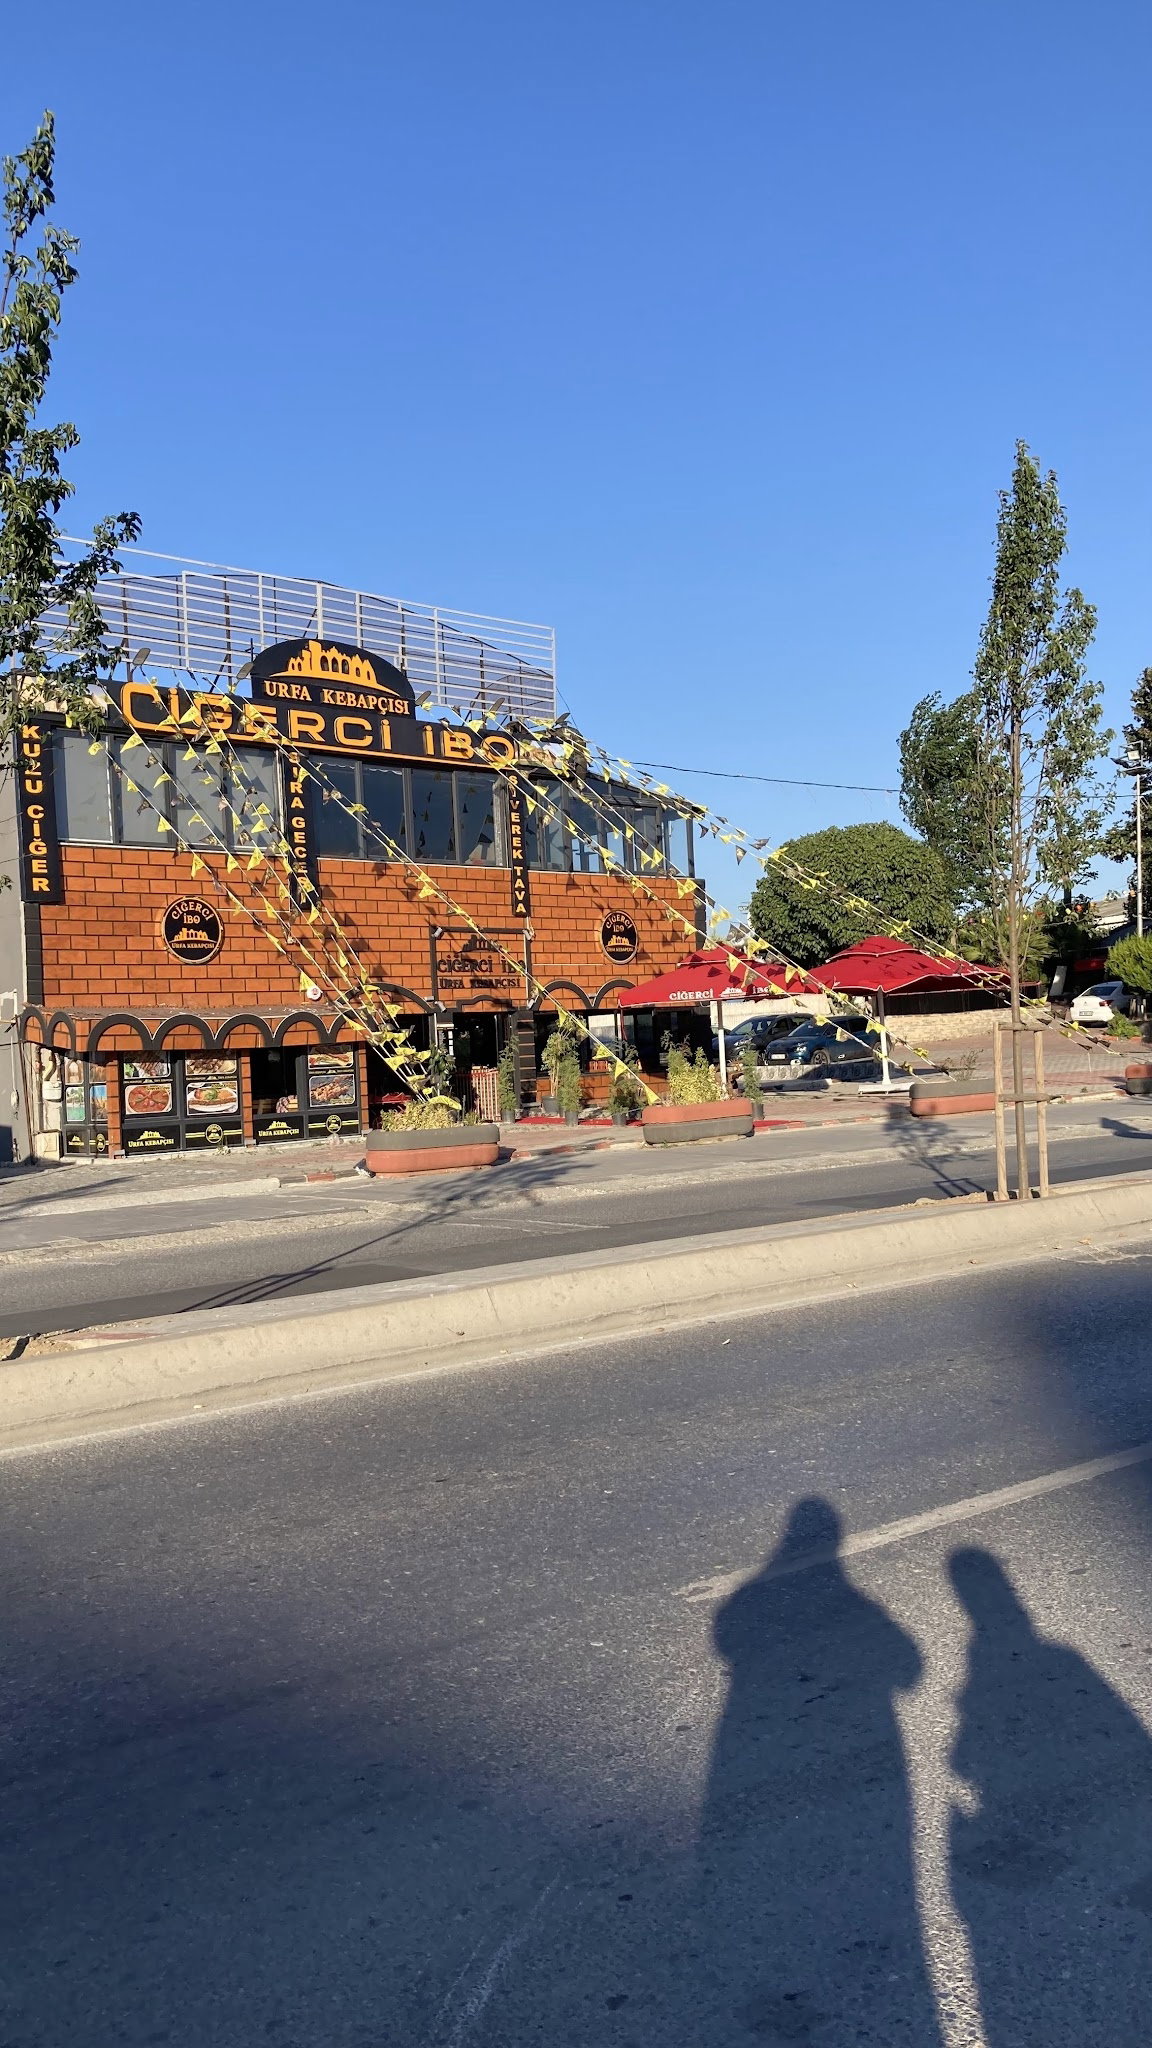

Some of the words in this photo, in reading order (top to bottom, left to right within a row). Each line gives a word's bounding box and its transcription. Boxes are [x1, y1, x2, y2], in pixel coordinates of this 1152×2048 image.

[264, 680, 312, 701] URFA
[320, 688, 410, 715] KEBAPÇISI
[22, 724, 43, 793] KUZU
[27, 804, 50, 892] CİĞER
[513, 866, 527, 913] TAVA
[171, 901, 215, 921] CİĞERCİ
[183, 913, 201, 924] İBO
[669, 988, 714, 1000] CİĞERCİ
[127, 1140, 144, 1148] URFA
